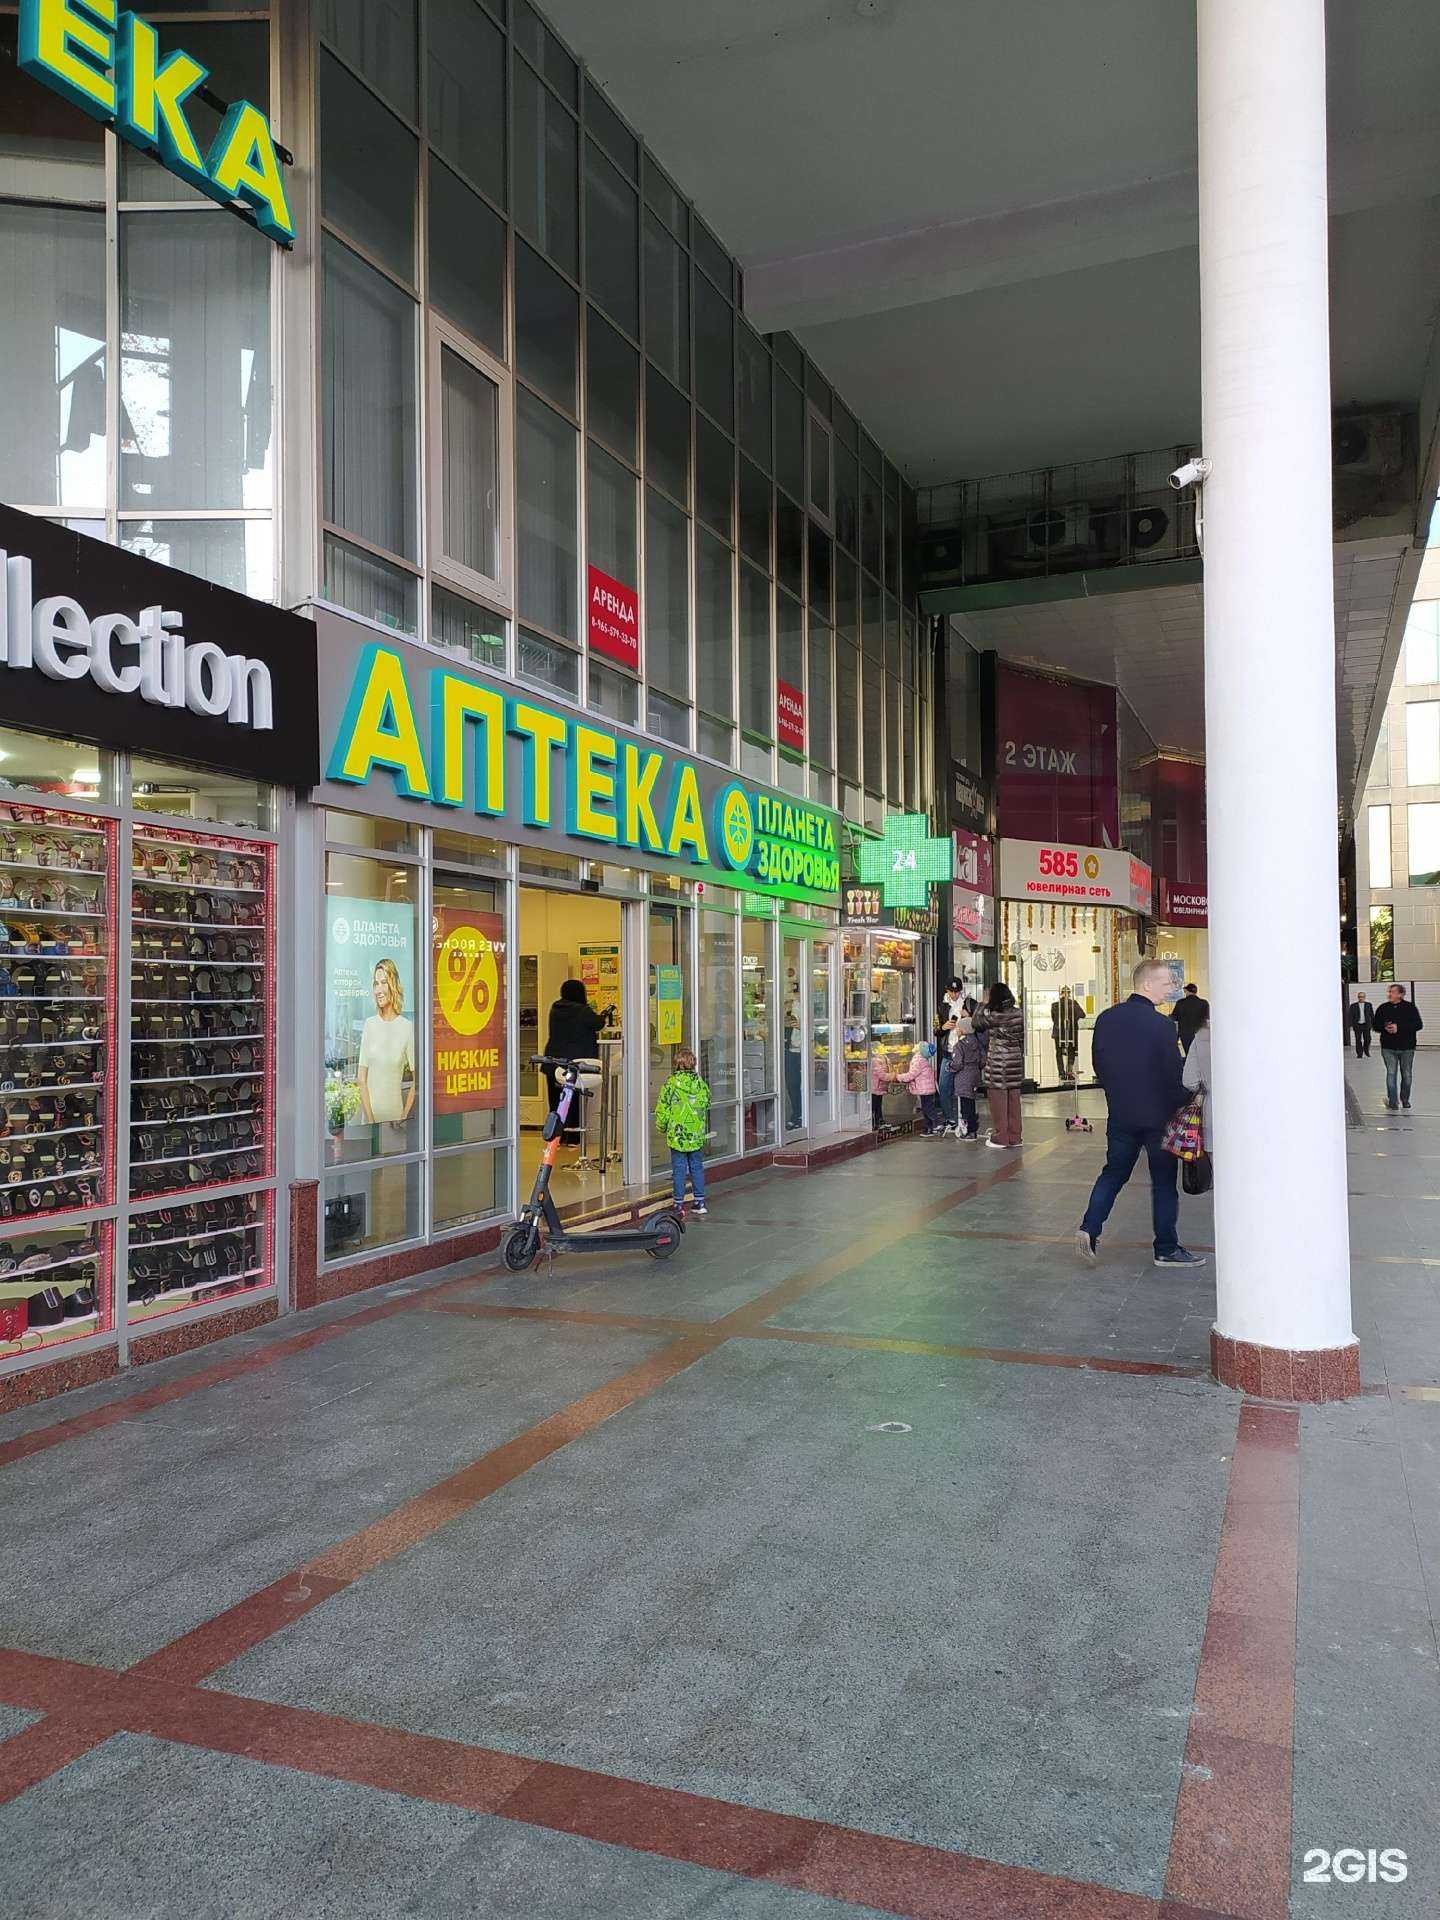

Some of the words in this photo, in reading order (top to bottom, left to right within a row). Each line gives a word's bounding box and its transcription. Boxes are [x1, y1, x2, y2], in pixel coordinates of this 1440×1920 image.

[18, 0, 295, 242] ЕКА
[592, 585, 635, 625] АРЕНДА
[326, 643, 709, 864] АПТЕКА
[1005, 741, 1017, 765] 2
[1022, 743, 1078, 775] ЭТАЖ
[756, 796, 835, 851] ПЛАНЕТА
[755, 840, 840, 892] ЗДОРОВЬЯ
[891, 848, 918, 872] 24
[1038, 849, 1079, 878] 585
[1026, 880, 1087, 897] ювелирная
[1088, 886, 1112, 898] сеть
[1172, 894, 1208, 906] МОСКОВ
[352, 933, 407, 948] ЗДОРОВЬЯ
[353, 919, 401, 935] ПЛАНЕТА
[437, 1048, 499, 1071] НИЗКИЕ
[446, 1071, 491, 1096] ЦЕНЫ
